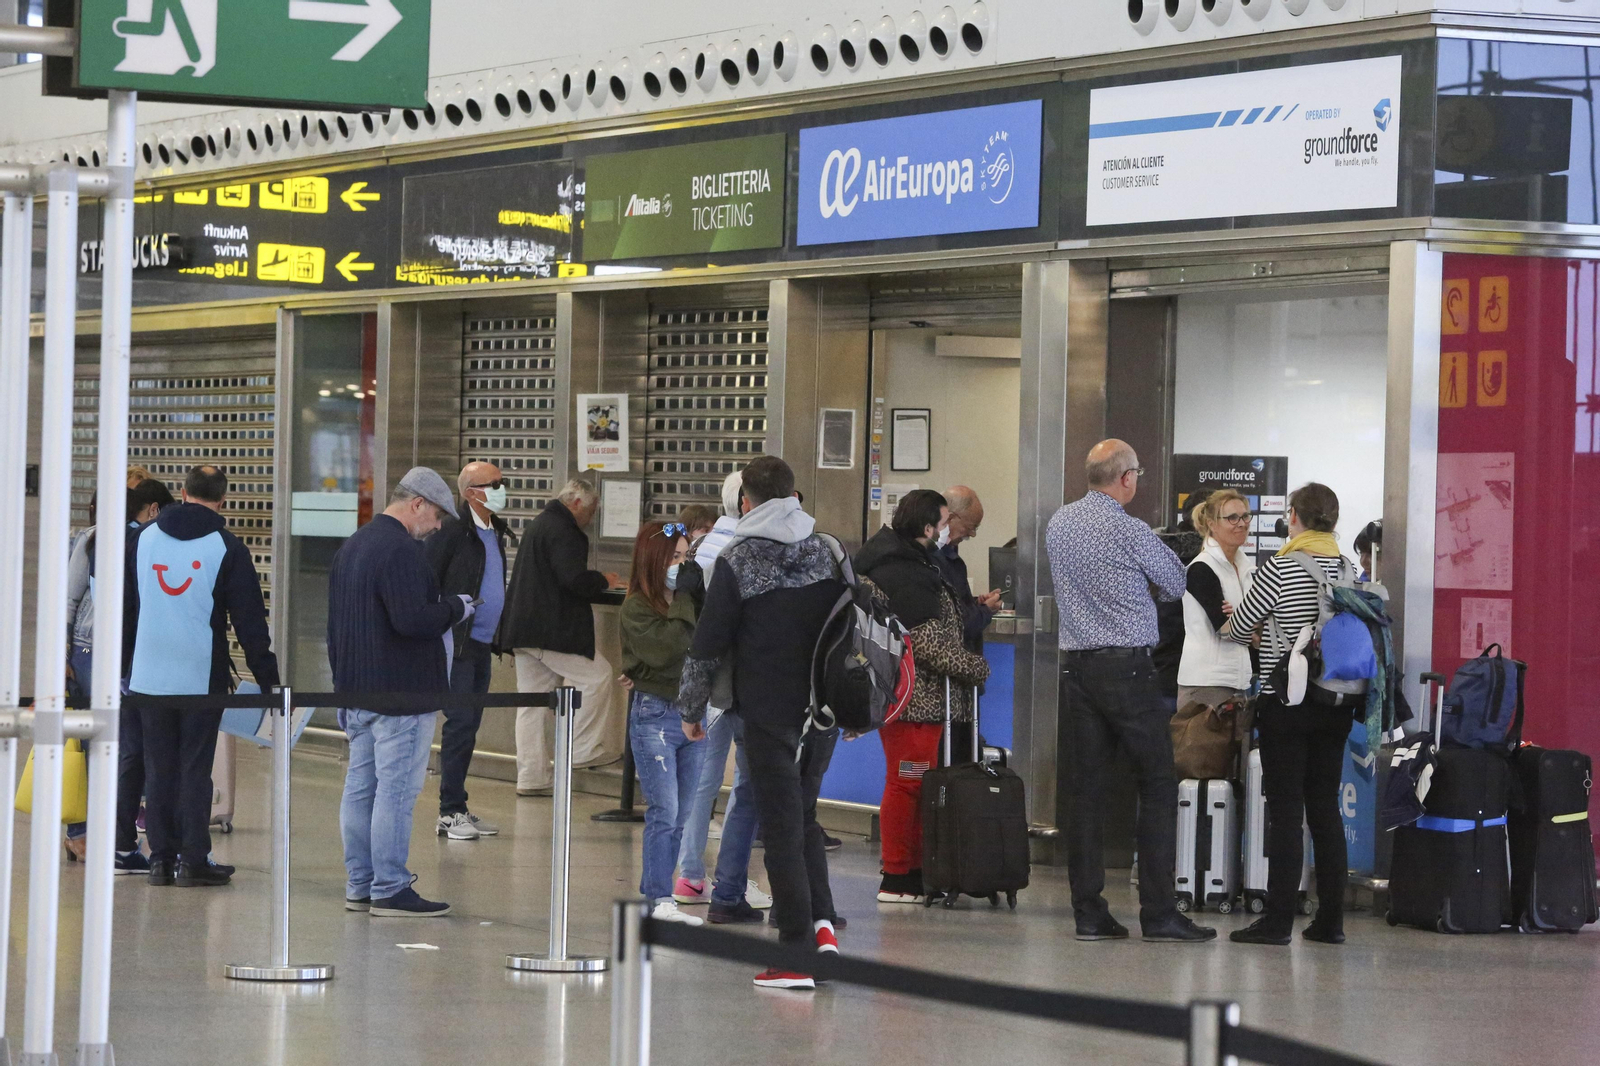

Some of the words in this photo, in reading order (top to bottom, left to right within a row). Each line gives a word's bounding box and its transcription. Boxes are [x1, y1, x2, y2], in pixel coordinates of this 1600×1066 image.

[1305, 109, 1332, 121] OPERATED
[1333, 107, 1341, 118] BY
[1304, 127, 1379, 164] groundforce
[1102, 156, 1132, 172] ATENCIÓN
[1132, 156, 1140, 169] AL
[1140, 155, 1164, 169] CLIENTE
[1334, 158, 1342, 167] We
[1343, 157, 1360, 167] handle,
[1361, 158, 1370, 167] you
[1370, 157, 1379, 167] fly.
[692, 168, 771, 200] BIGLIETTERIA
[863, 156, 974, 205] AirEuropa
[1102, 175, 1134, 190] CUSTOMER
[1134, 174, 1160, 188] SERVICE
[624, 193, 660, 217] Alitalia
[692, 202, 753, 231] TICKETING
[80, 233, 170, 273] STAUCKS
[1199, 468, 1255, 483] groundforce
